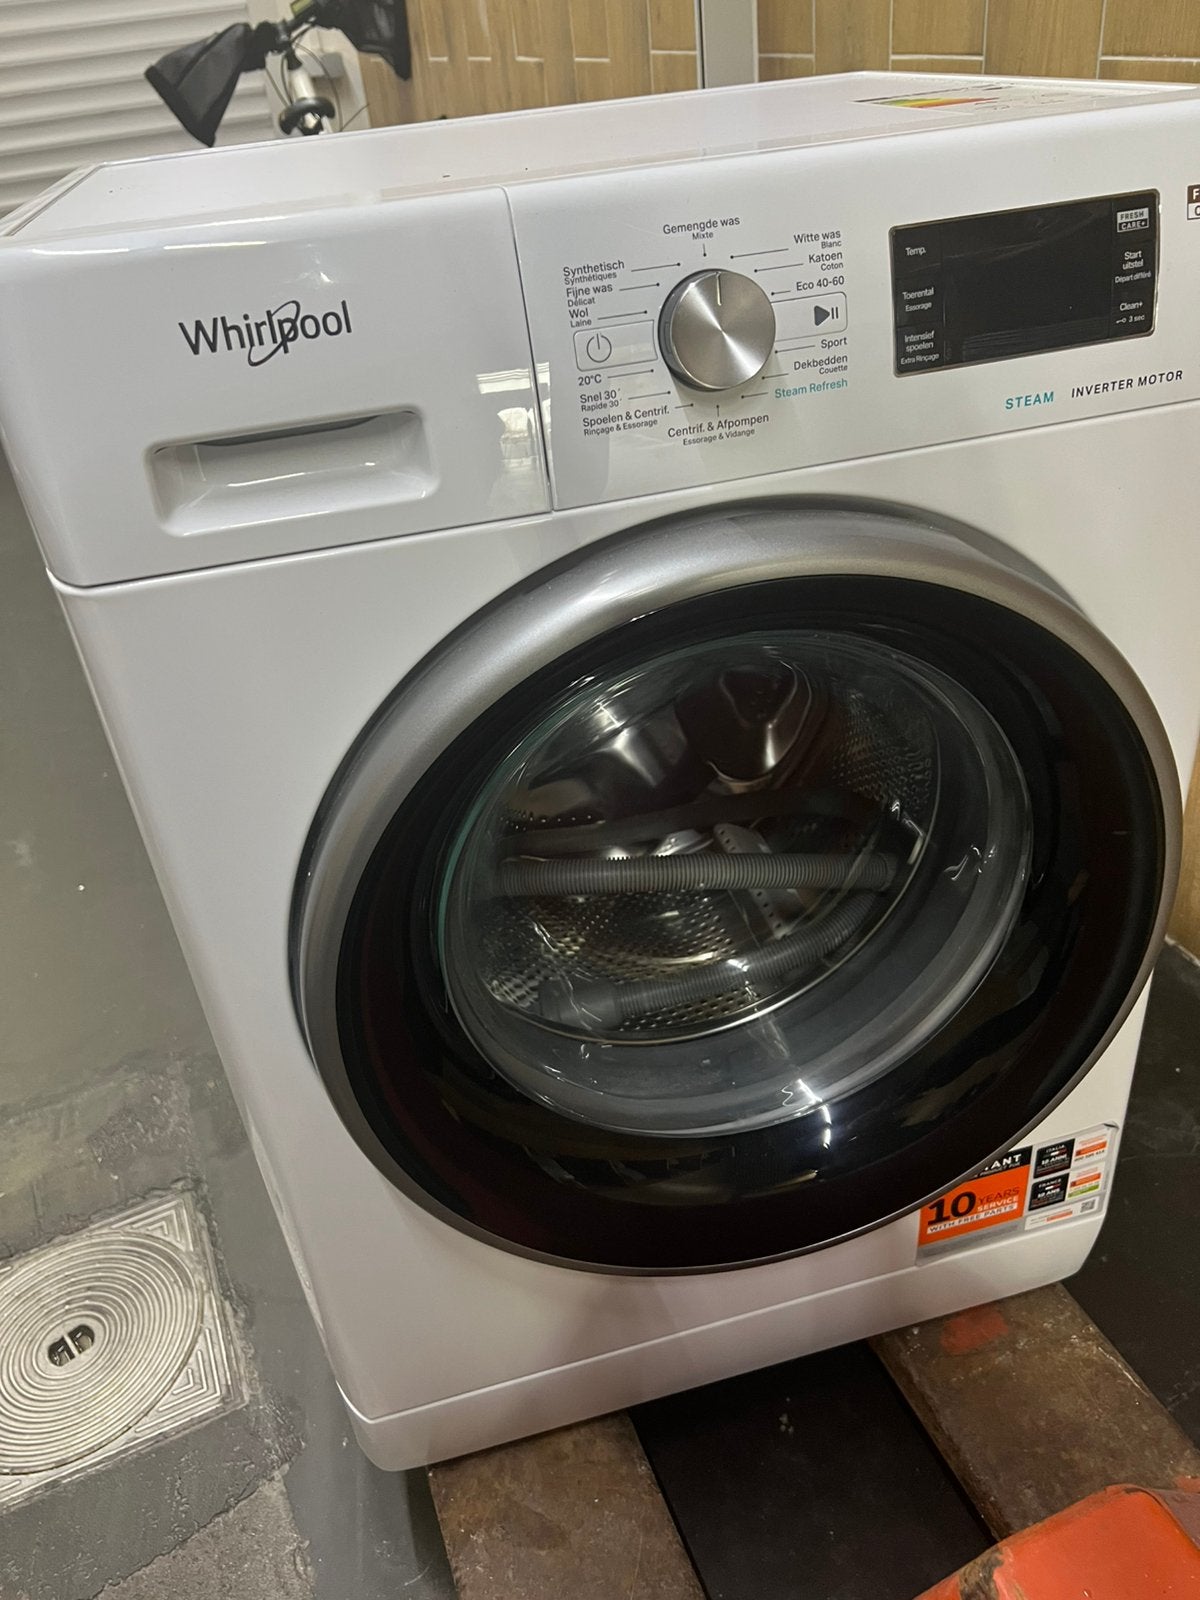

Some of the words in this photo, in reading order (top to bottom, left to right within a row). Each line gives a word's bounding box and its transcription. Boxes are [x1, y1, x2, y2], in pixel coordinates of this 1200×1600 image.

[1120, 211, 1144, 220] FRESH
[663, 219, 718, 235] Gemengde
[721, 217, 740, 227] was
[1121, 220, 1145, 230] CARE+
[692, 231, 713, 240] Mixte
[794, 232, 819, 244] Witte
[821, 231, 841, 240] was
[821, 239, 842, 248] Blanc
[809, 250, 843, 263] Katoen
[906, 247, 926, 256] Temp.
[1124, 250, 1142, 260] Start
[563, 260, 625, 277] Synthetisch
[821, 262, 844, 271] Coton
[1122, 259, 1144, 270] uitstel
[565, 272, 617, 285] Synthétiques
[796, 281, 814, 291] Eco
[816, 276, 845, 288] 40-60
[1115, 274, 1133, 284] Départ
[566, 285, 590, 298] Fijne
[593, 283, 613, 293] was
[902, 287, 934, 300] Toerental
[568, 297, 595, 307] Délicat
[906, 302, 932, 312] Essorage
[1120, 302, 1142, 312] Clean+
[569, 308, 589, 318] Wol
[1134, 314, 1145, 322] sec
[570, 318, 592, 327] Laine
[178, 299, 352, 367] Whirlpool
[905, 330, 934, 342] Intensief
[821, 337, 847, 349] Sport
[906, 341, 934, 353] spoelen
[794, 355, 848, 371] Dekbedden
[901, 357, 915, 365] Extra
[916, 353, 939, 362] Rinçage
[819, 364, 848, 375] Couette
[578, 374, 602, 386] 20°C
[1072, 378, 1134, 398] INVERTER
[1138, 370, 1183, 388] MOTOR
[775, 387, 807, 399] Steam
[809, 379, 848, 395] Refresh
[580, 393, 602, 403] Snel
[1006, 391, 1054, 410] STEAM
[581, 401, 607, 413] Rapide
[582, 413, 623, 428] Spoelen
[626, 412, 632, 420] &
[634, 406, 670, 419] Centrif.
[583, 425, 614, 437] Rinçage
[623, 418, 658, 431] Essorage
[668, 424, 705, 438] Centrif.
[707, 422, 715, 431] &
[717, 414, 769, 430] Afpompen
[683, 434, 717, 446] Essorage
[726, 428, 755, 440] Vidange
[927, 1191, 976, 1225] 10
[978, 1187, 1020, 1204] YEARS
[977, 1196, 1019, 1212] SERVICE
[930, 1221, 955, 1233] WITH
[958, 1213, 982, 1225] FREE
[984, 1204, 1015, 1218] PARTS
